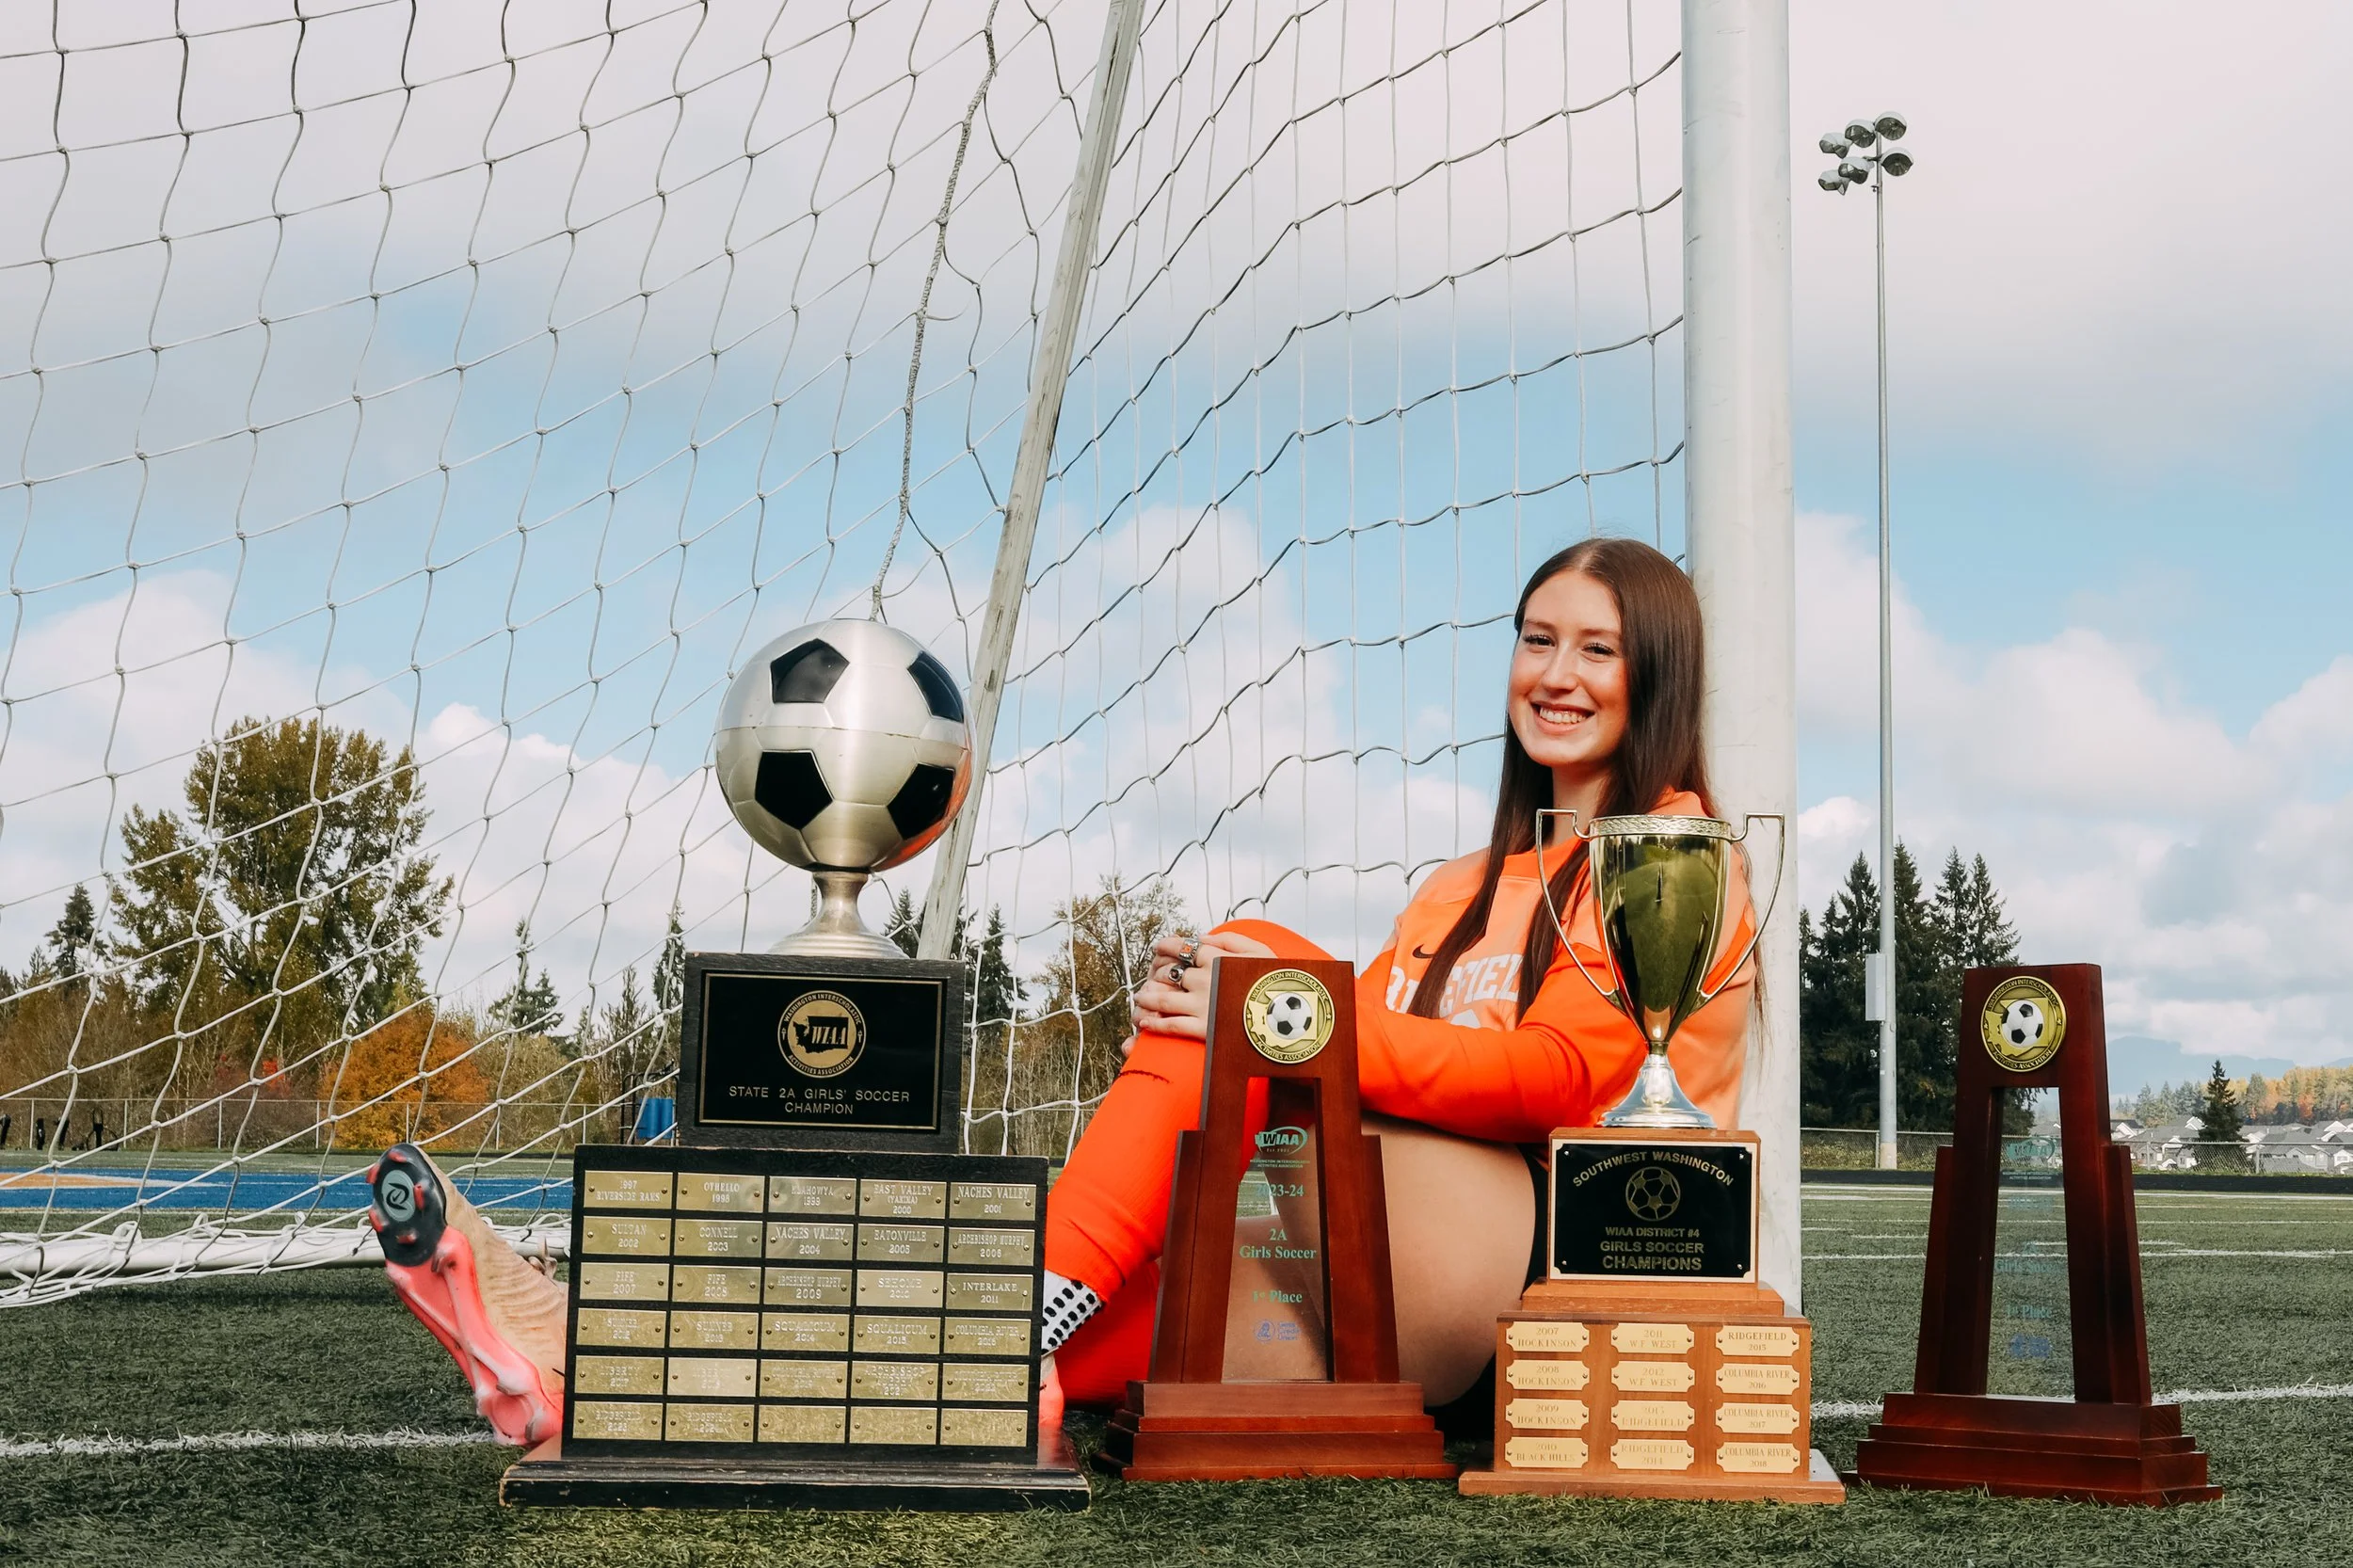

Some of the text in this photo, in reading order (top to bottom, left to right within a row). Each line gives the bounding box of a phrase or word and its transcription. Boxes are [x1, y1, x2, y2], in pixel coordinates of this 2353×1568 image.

[1251, 972, 1329, 1000] WASHINGTON INTERSCHOLASTIC
[1988, 980, 2058, 1009] WASHINGTON INTERSCHOLASTIC
[784, 994, 861, 1024] WASHINGTON INTERSCHOLASTIC
[1257, 1042, 1320, 1060] ACTIVITIES ASSOCIATION
[2019, 1049, 2052, 1069] ASSOCIATION
[788, 1055, 854, 1075] ACTIVITIES ASSOCIATION
[729, 1086, 910, 1102] STATE 2A GIRLS' SOCCER
[785, 1102, 854, 1114] CHAMPION
[1263, 1133, 1300, 1146] WIAA
[1573, 1151, 1734, 1188] SOUTHWEST WASHINGTON
[619, 1180, 637, 1190] 1997
[704, 1182, 739, 1192] OTHELLO
[873, 1184, 933, 1195] EAST VALLEY
[596, 1192, 660, 1201] RIVERSIDE RAMS
[958, 1186, 1029, 1199] NACHES VALLEY
[712, 1194, 729, 1203] 1998
[804, 1196, 821, 1206] 1999
[892, 1206, 912, 1214] 2000
[984, 1205, 1002, 1213] 2001
[611, 1224, 647, 1235] SULTAN
[699, 1227, 738, 1238] CONNELL
[776, 1226, 845, 1240] NACHES VALLEY
[1269, 1228, 1288, 1240] 2A
[1606, 1227, 1700, 1238] WIAA DISTRICT #4
[873, 1229, 926, 1242] EATONVILLE
[958, 1234, 1025, 1246] ARCHBISHOP MURPHY
[618, 1239, 639, 1248] 2002
[708, 1241, 728, 1252] 2003
[889, 1244, 910, 1254] 2005
[1600, 1241, 1705, 1253] GIRLS SOCCER
[799, 1244, 821, 1255] 2004
[1240, 1245, 1317, 1259] Girls Soccer
[1603, 1256, 1702, 1271] CHAMPIONS
[1995, 1260, 2023, 1272] Girls
[616, 1272, 635, 1282] FIFE
[707, 1274, 727, 1284] FIFE
[878, 1278, 922, 1288] SEHOME
[962, 1282, 1017, 1292] INTERLAKE
[613, 1284, 636, 1294] 2007
[704, 1287, 728, 1297] 2008
[796, 1288, 822, 1299] 2009
[981, 1295, 999, 1304] 2011
[1270, 1290, 1303, 1303] Place
[775, 1321, 836, 1332] SQUALICUM
[867, 1323, 927, 1335] SQUALICUM
[794, 1334, 815, 1342] 2014
[1728, 1332, 1787, 1340] RIDGEFIELD
[1517, 1338, 1577, 1347] HOCKINSON
[1642, 1368, 1664, 1376] 2012
[1724, 1368, 1790, 1379] COLUMBIA RIVER
[1517, 1378, 1577, 1386] HOCKINSON
[1536, 1404, 1560, 1413] 2009
[1724, 1408, 1790, 1417] COLUMBIA RIVER
[1517, 1416, 1577, 1424] HOCKINSON
[1749, 1420, 1766, 1429] 2017
[1536, 1442, 1558, 1450] 2010
[1621, 1445, 1684, 1453] RIDGEFIELD
[1548, 1453, 1576, 1462] HILLS
[1725, 1447, 1791, 1457] COLUMBIA RIVER
